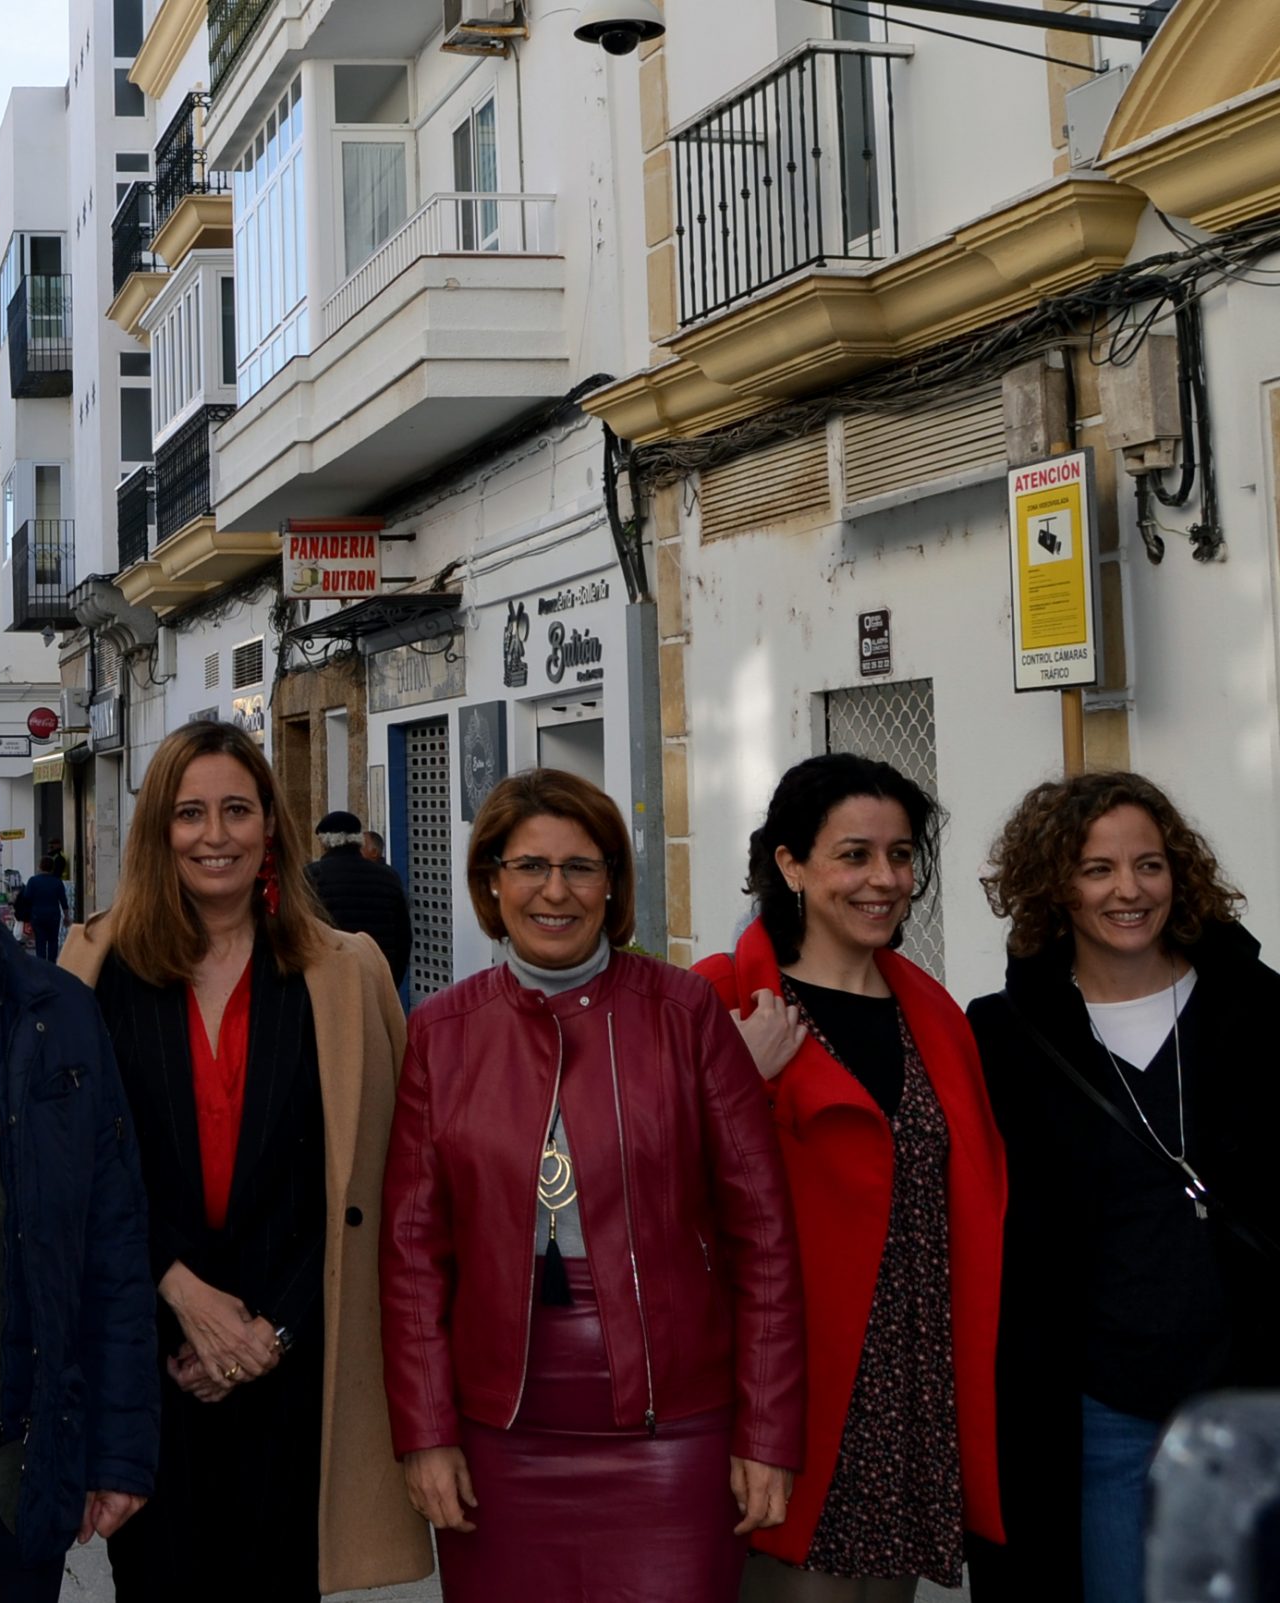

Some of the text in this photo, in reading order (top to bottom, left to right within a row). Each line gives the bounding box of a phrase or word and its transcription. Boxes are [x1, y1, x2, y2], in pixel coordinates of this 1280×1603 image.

[1015, 460, 1081, 492] ATENCIÓN
[289, 535, 376, 560] PANADERIA
[322, 569, 376, 592] BUTRON
[546, 620, 603, 684] Butrón
[1021, 647, 1088, 667] CONTROL CÁMARAS
[1040, 666, 1069, 681] TRÁFICO
